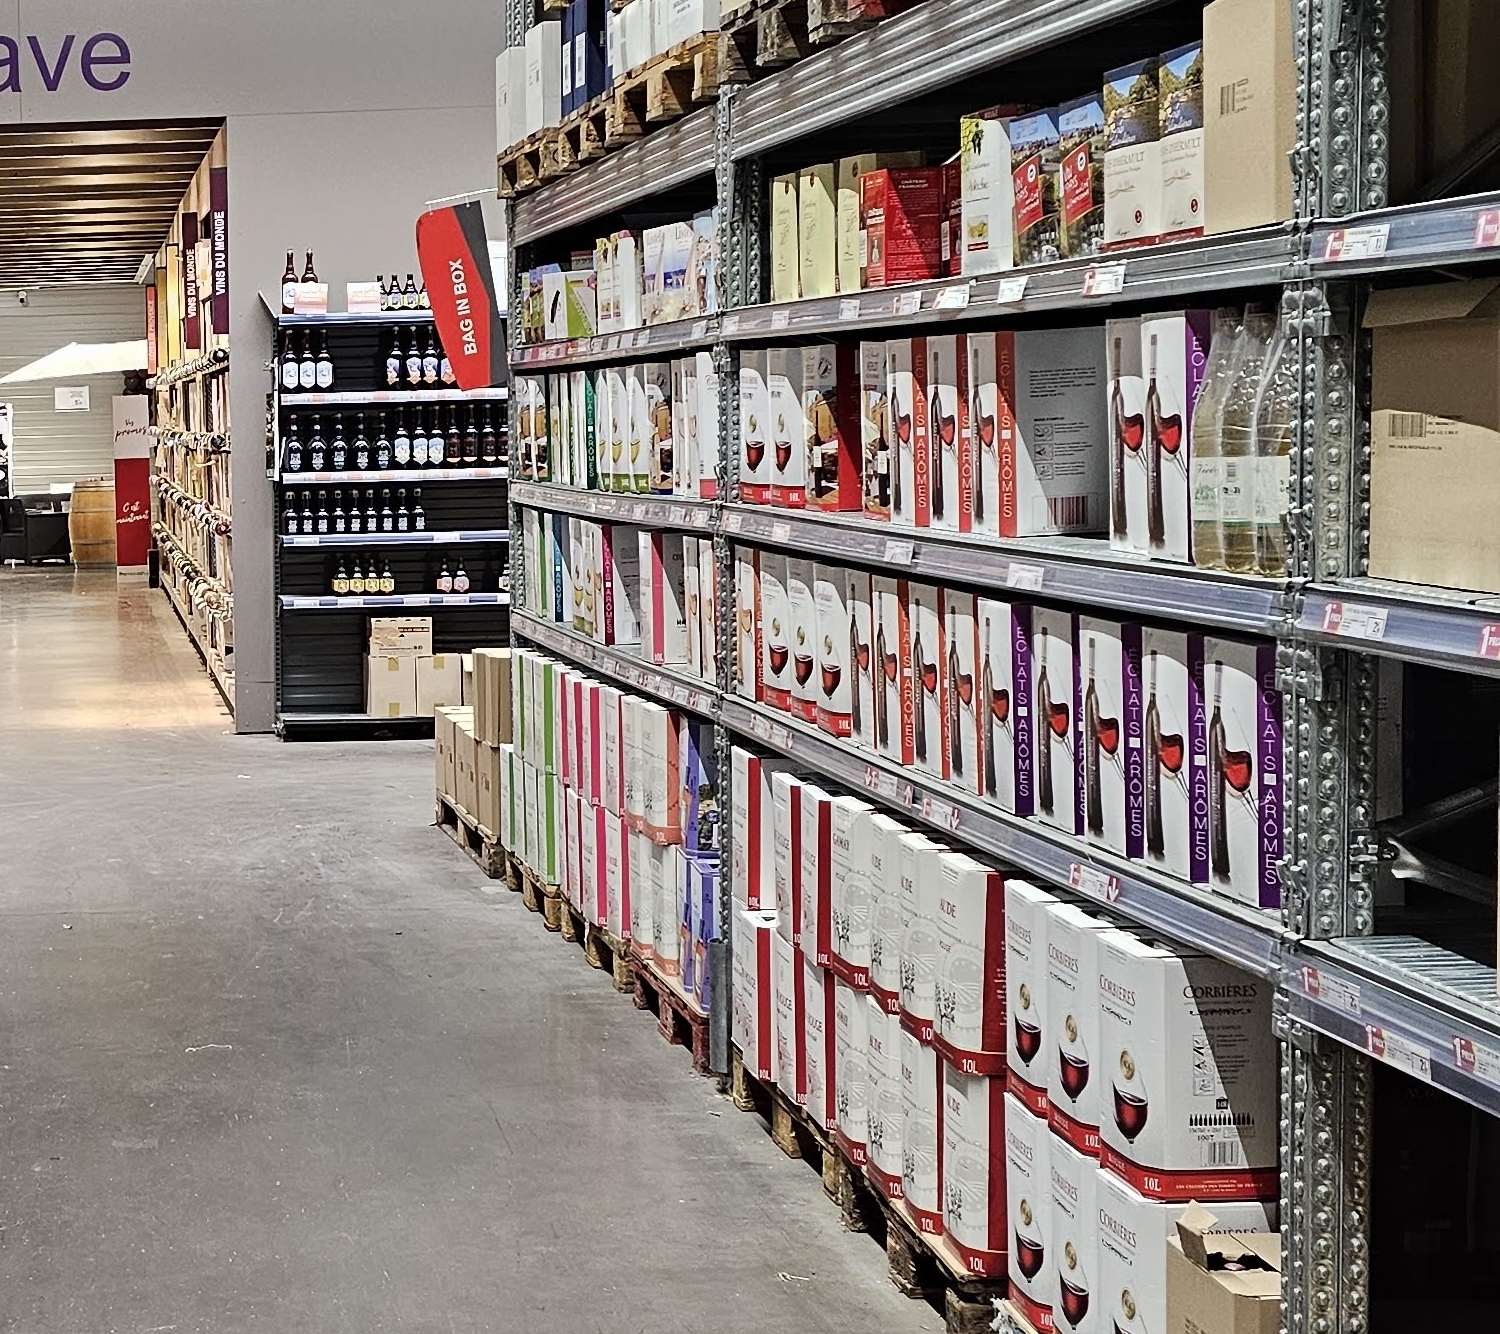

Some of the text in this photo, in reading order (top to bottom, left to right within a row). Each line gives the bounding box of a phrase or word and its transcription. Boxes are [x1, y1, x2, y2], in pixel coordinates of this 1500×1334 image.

[213, 211, 226, 295] VINS DU MONDE
[185, 248, 197, 317] VINS DU MONDE
[448, 259, 478, 356] BAG IN BOX
[115, 425, 147, 443] promos
[817, 953, 830, 965] 10L
[1049, 942, 1079, 974] CORBIÈRES
[854, 972, 868, 986] 10L
[1099, 973, 1136, 1007] CORBIÈRES
[1183, 983, 1258, 1000] CORBIÈRES
[759, 1069, 771, 1081] 10L
[962, 1058, 979, 1075] 10L
[852, 1148, 867, 1163] 10L
[889, 1182, 903, 1197] 10L
[1051, 1165, 1079, 1202] CORBIÈRES
[1143, 1176, 1162, 1192] 10L
[921, 1217, 936, 1234] 10L
[1099, 1207, 1137, 1248] CORBIÈRES
[969, 1256, 986, 1273] 10L
